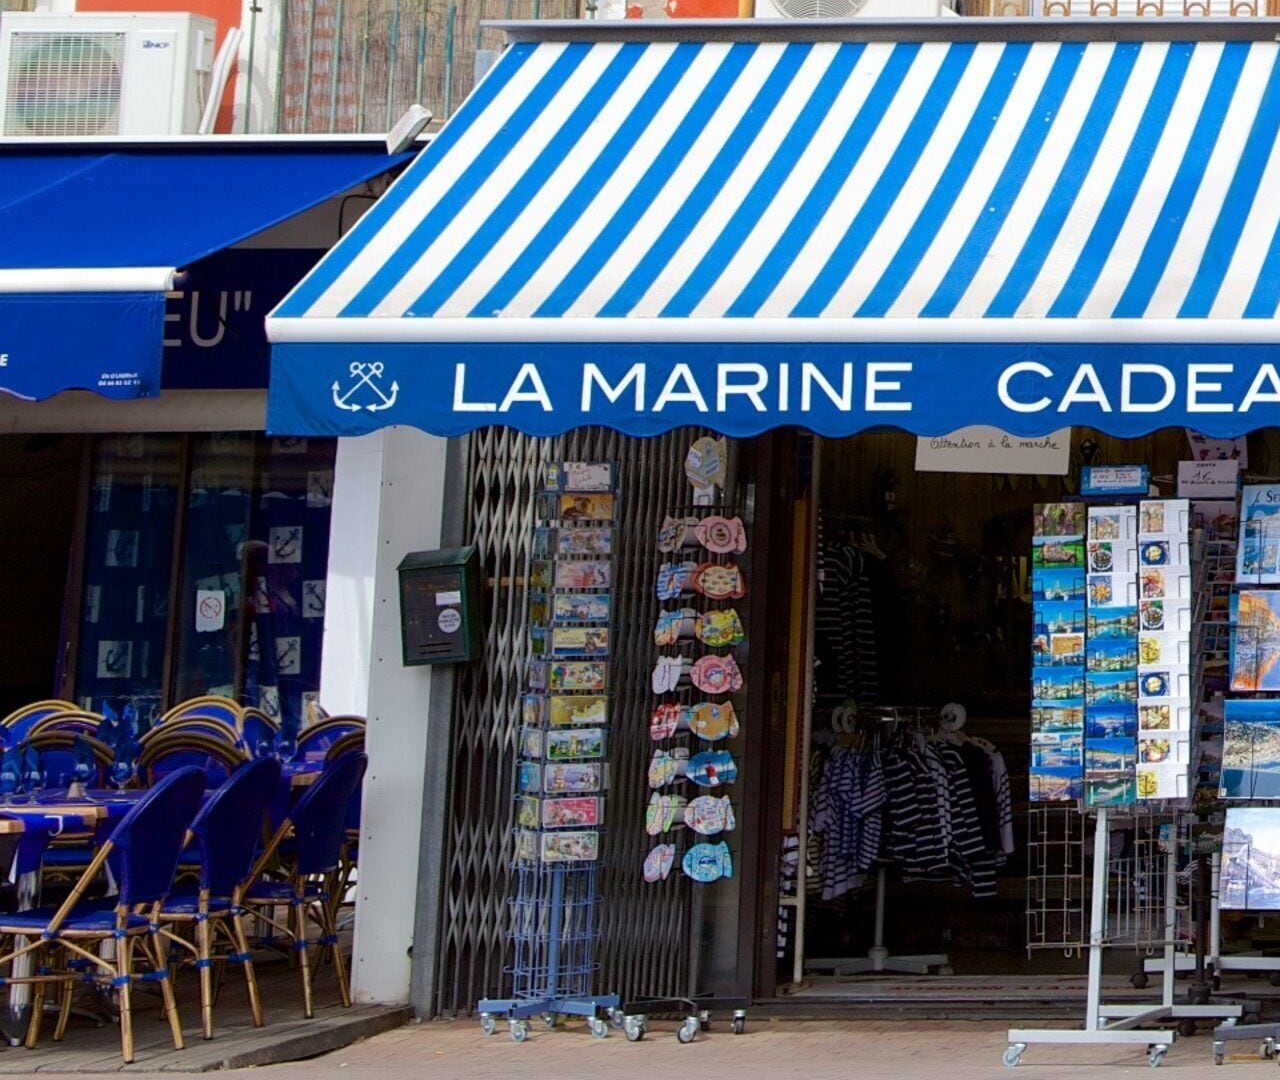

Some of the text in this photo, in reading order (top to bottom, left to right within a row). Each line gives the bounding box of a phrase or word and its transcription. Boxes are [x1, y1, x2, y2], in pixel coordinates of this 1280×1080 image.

[452, 363, 553, 412] LA
[581, 362, 913, 412] MARINE
[1019, 436, 1061, 450] marche
